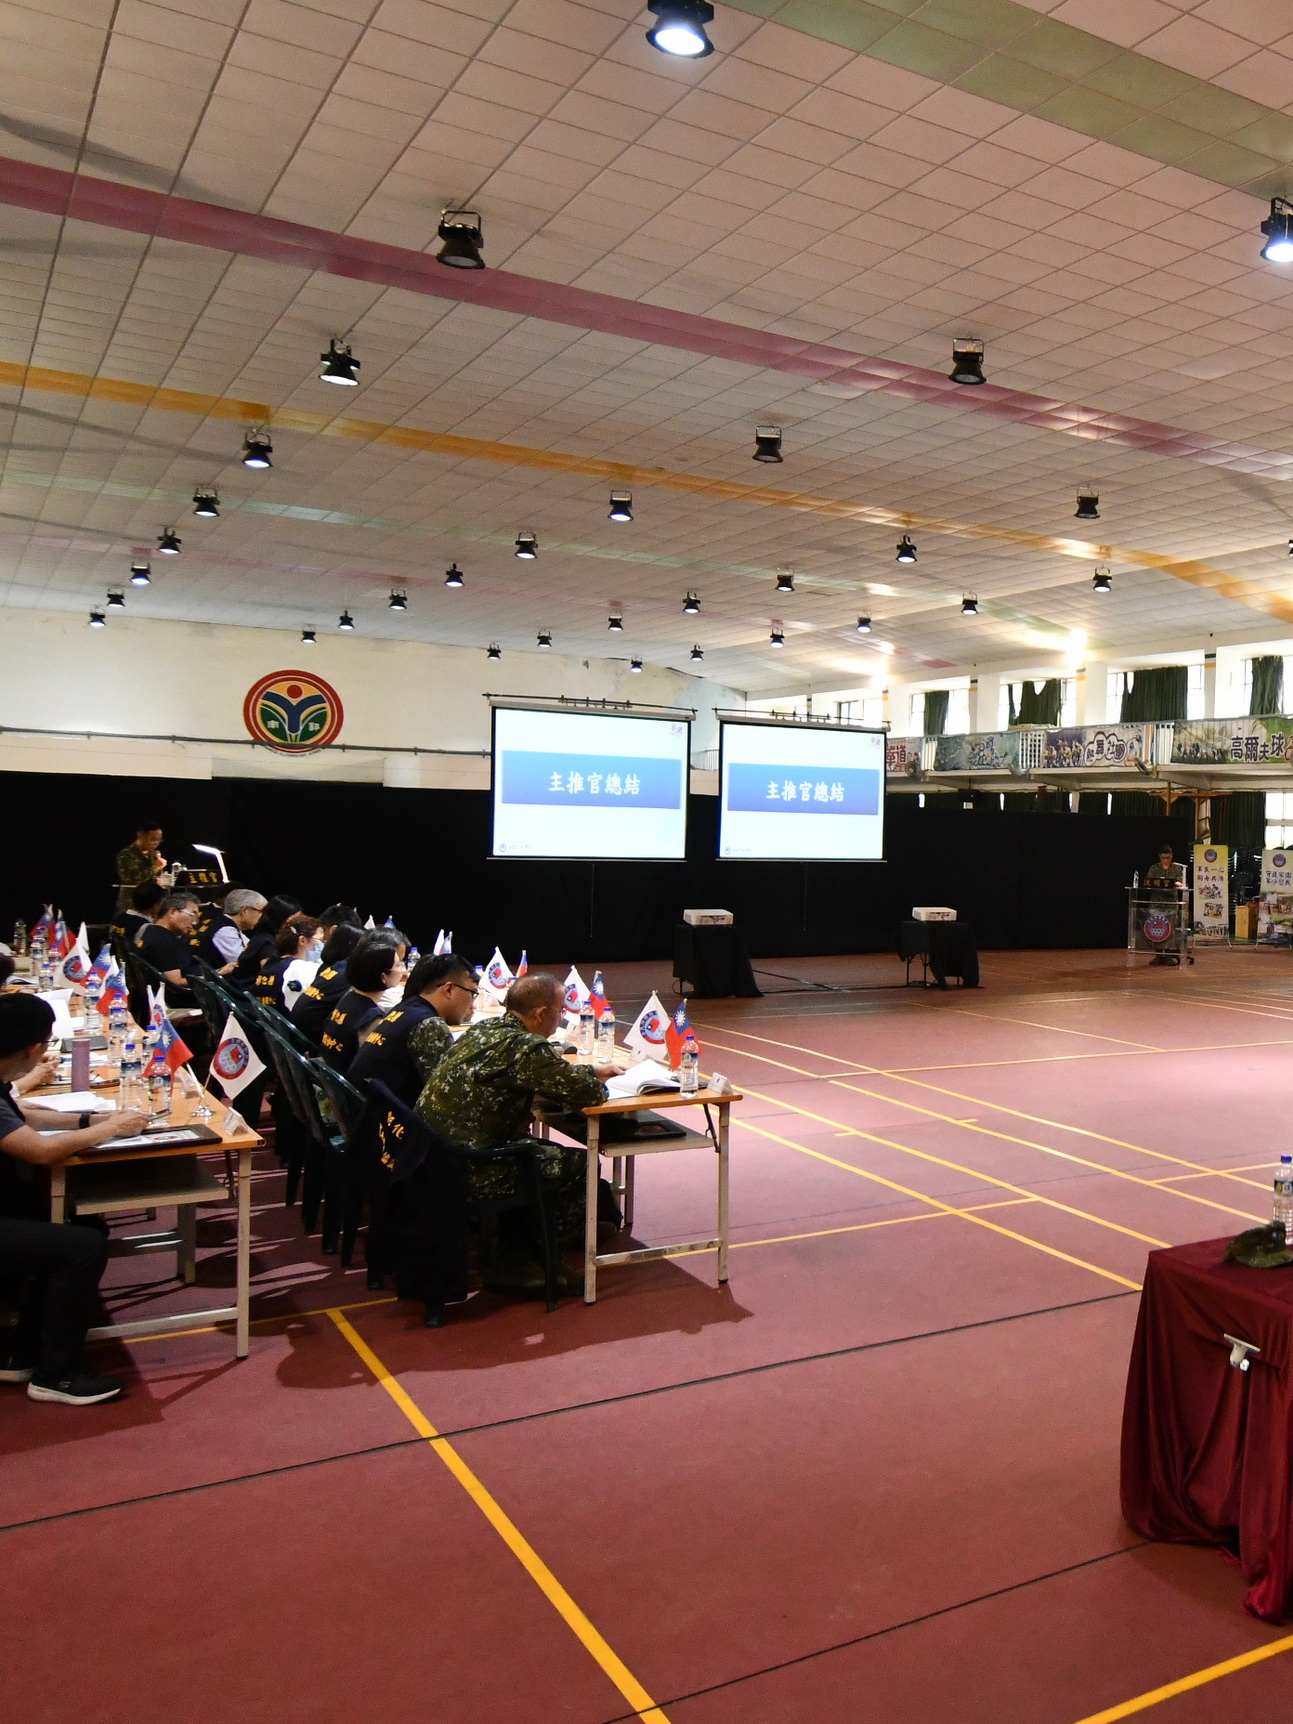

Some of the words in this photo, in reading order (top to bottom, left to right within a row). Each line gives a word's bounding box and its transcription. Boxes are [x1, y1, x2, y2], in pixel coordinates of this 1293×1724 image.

[548, 770, 641, 796] 主推官總結
[765, 779, 845, 803] 主推官總結
